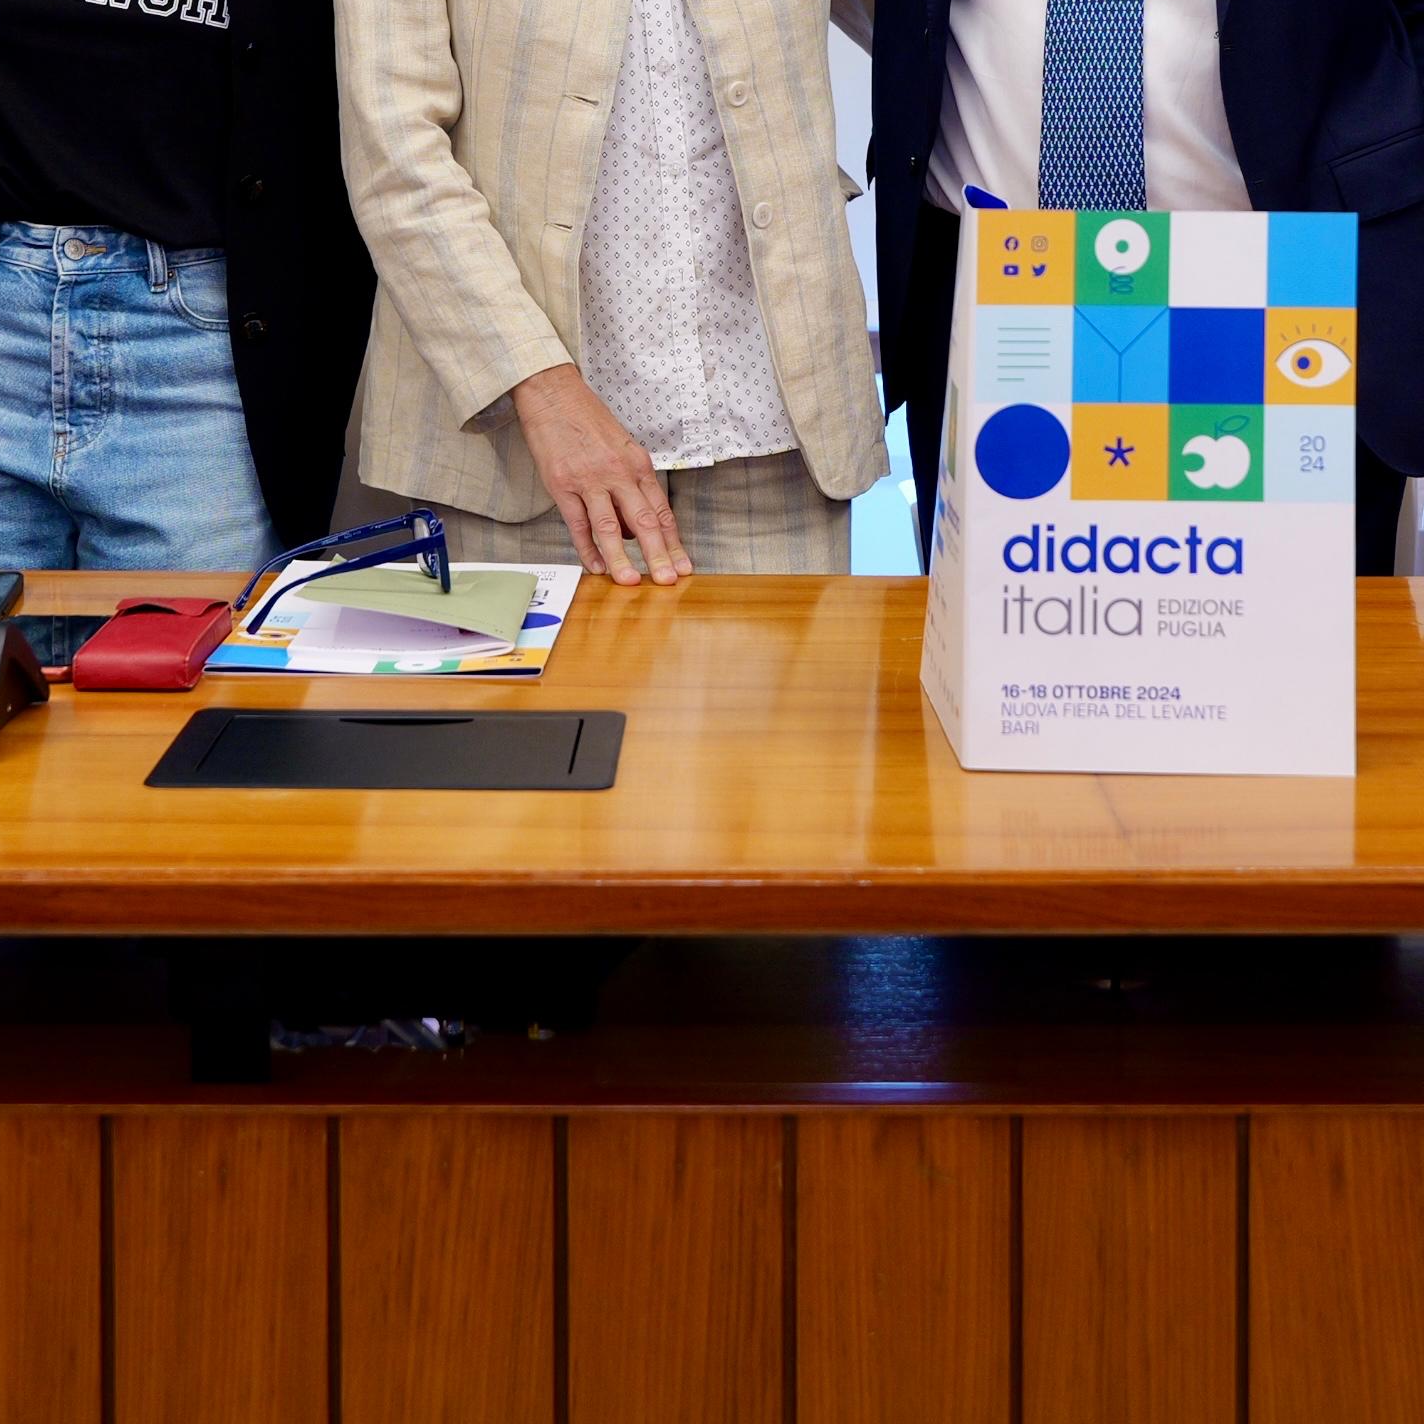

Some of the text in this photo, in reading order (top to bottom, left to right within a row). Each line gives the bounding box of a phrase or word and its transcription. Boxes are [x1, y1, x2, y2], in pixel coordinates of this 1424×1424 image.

[1299, 435, 1325, 452] 20
[1299, 455, 1325, 472] 24
[1003, 524, 1244, 575] didacta
[1003, 584, 1244, 636] italia EDIZIONE
[1157, 620, 1226, 638] PUGLIA
[1001, 684, 1182, 701] 16-18 OTTOBRE 2024
[1001, 702, 1227, 720] NUOVA FIERA DEL LEVANTE
[1001, 720, 1040, 736] BARI
